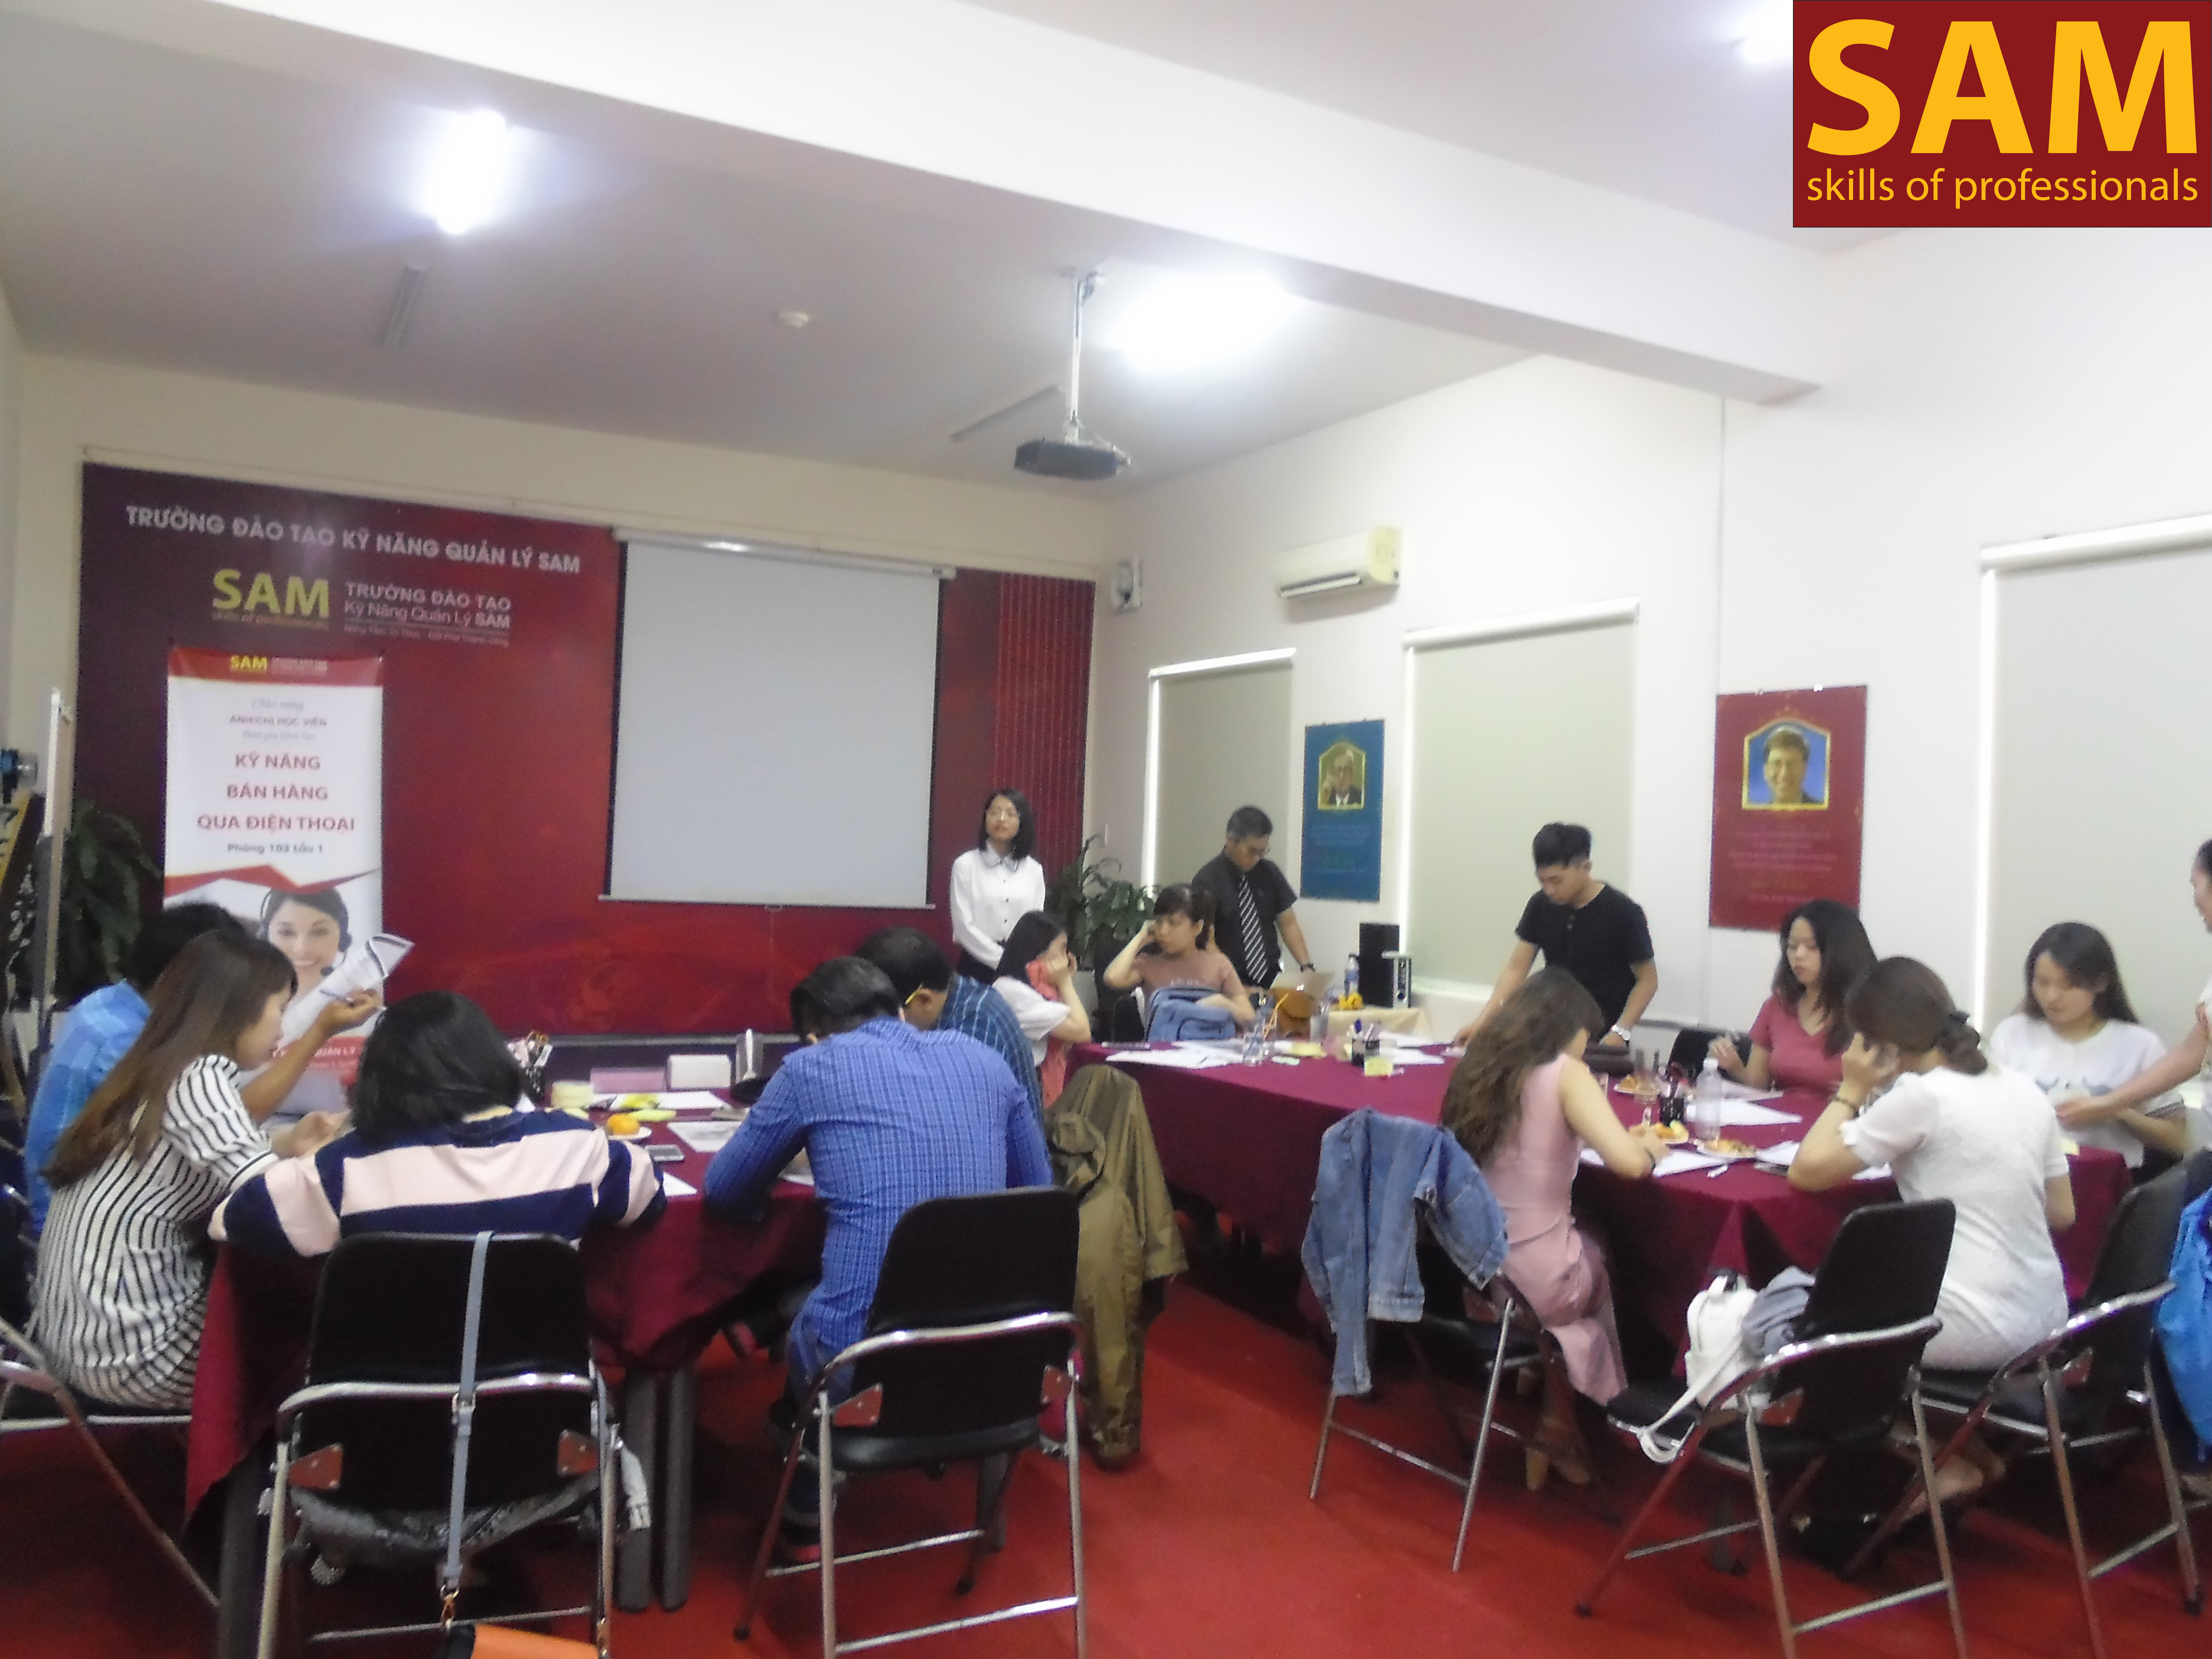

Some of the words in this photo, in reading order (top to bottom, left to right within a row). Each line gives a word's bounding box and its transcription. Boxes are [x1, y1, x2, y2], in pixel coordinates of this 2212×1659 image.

[126, 505, 224, 534] TRƯỜNG
[376, 531, 439, 558] NĂNG
[512, 545, 532, 568] LÝ
[539, 553, 580, 574] SAM
[213, 568, 329, 618] SAM
[474, 611, 511, 629] SAM
[230, 655, 268, 670] SAM
[227, 783, 267, 799] BÁN
[272, 783, 328, 800] HÀNG
[197, 815, 240, 830] QUA
[246, 813, 291, 834] ĐIỆN
[297, 817, 355, 835] THOẠI
